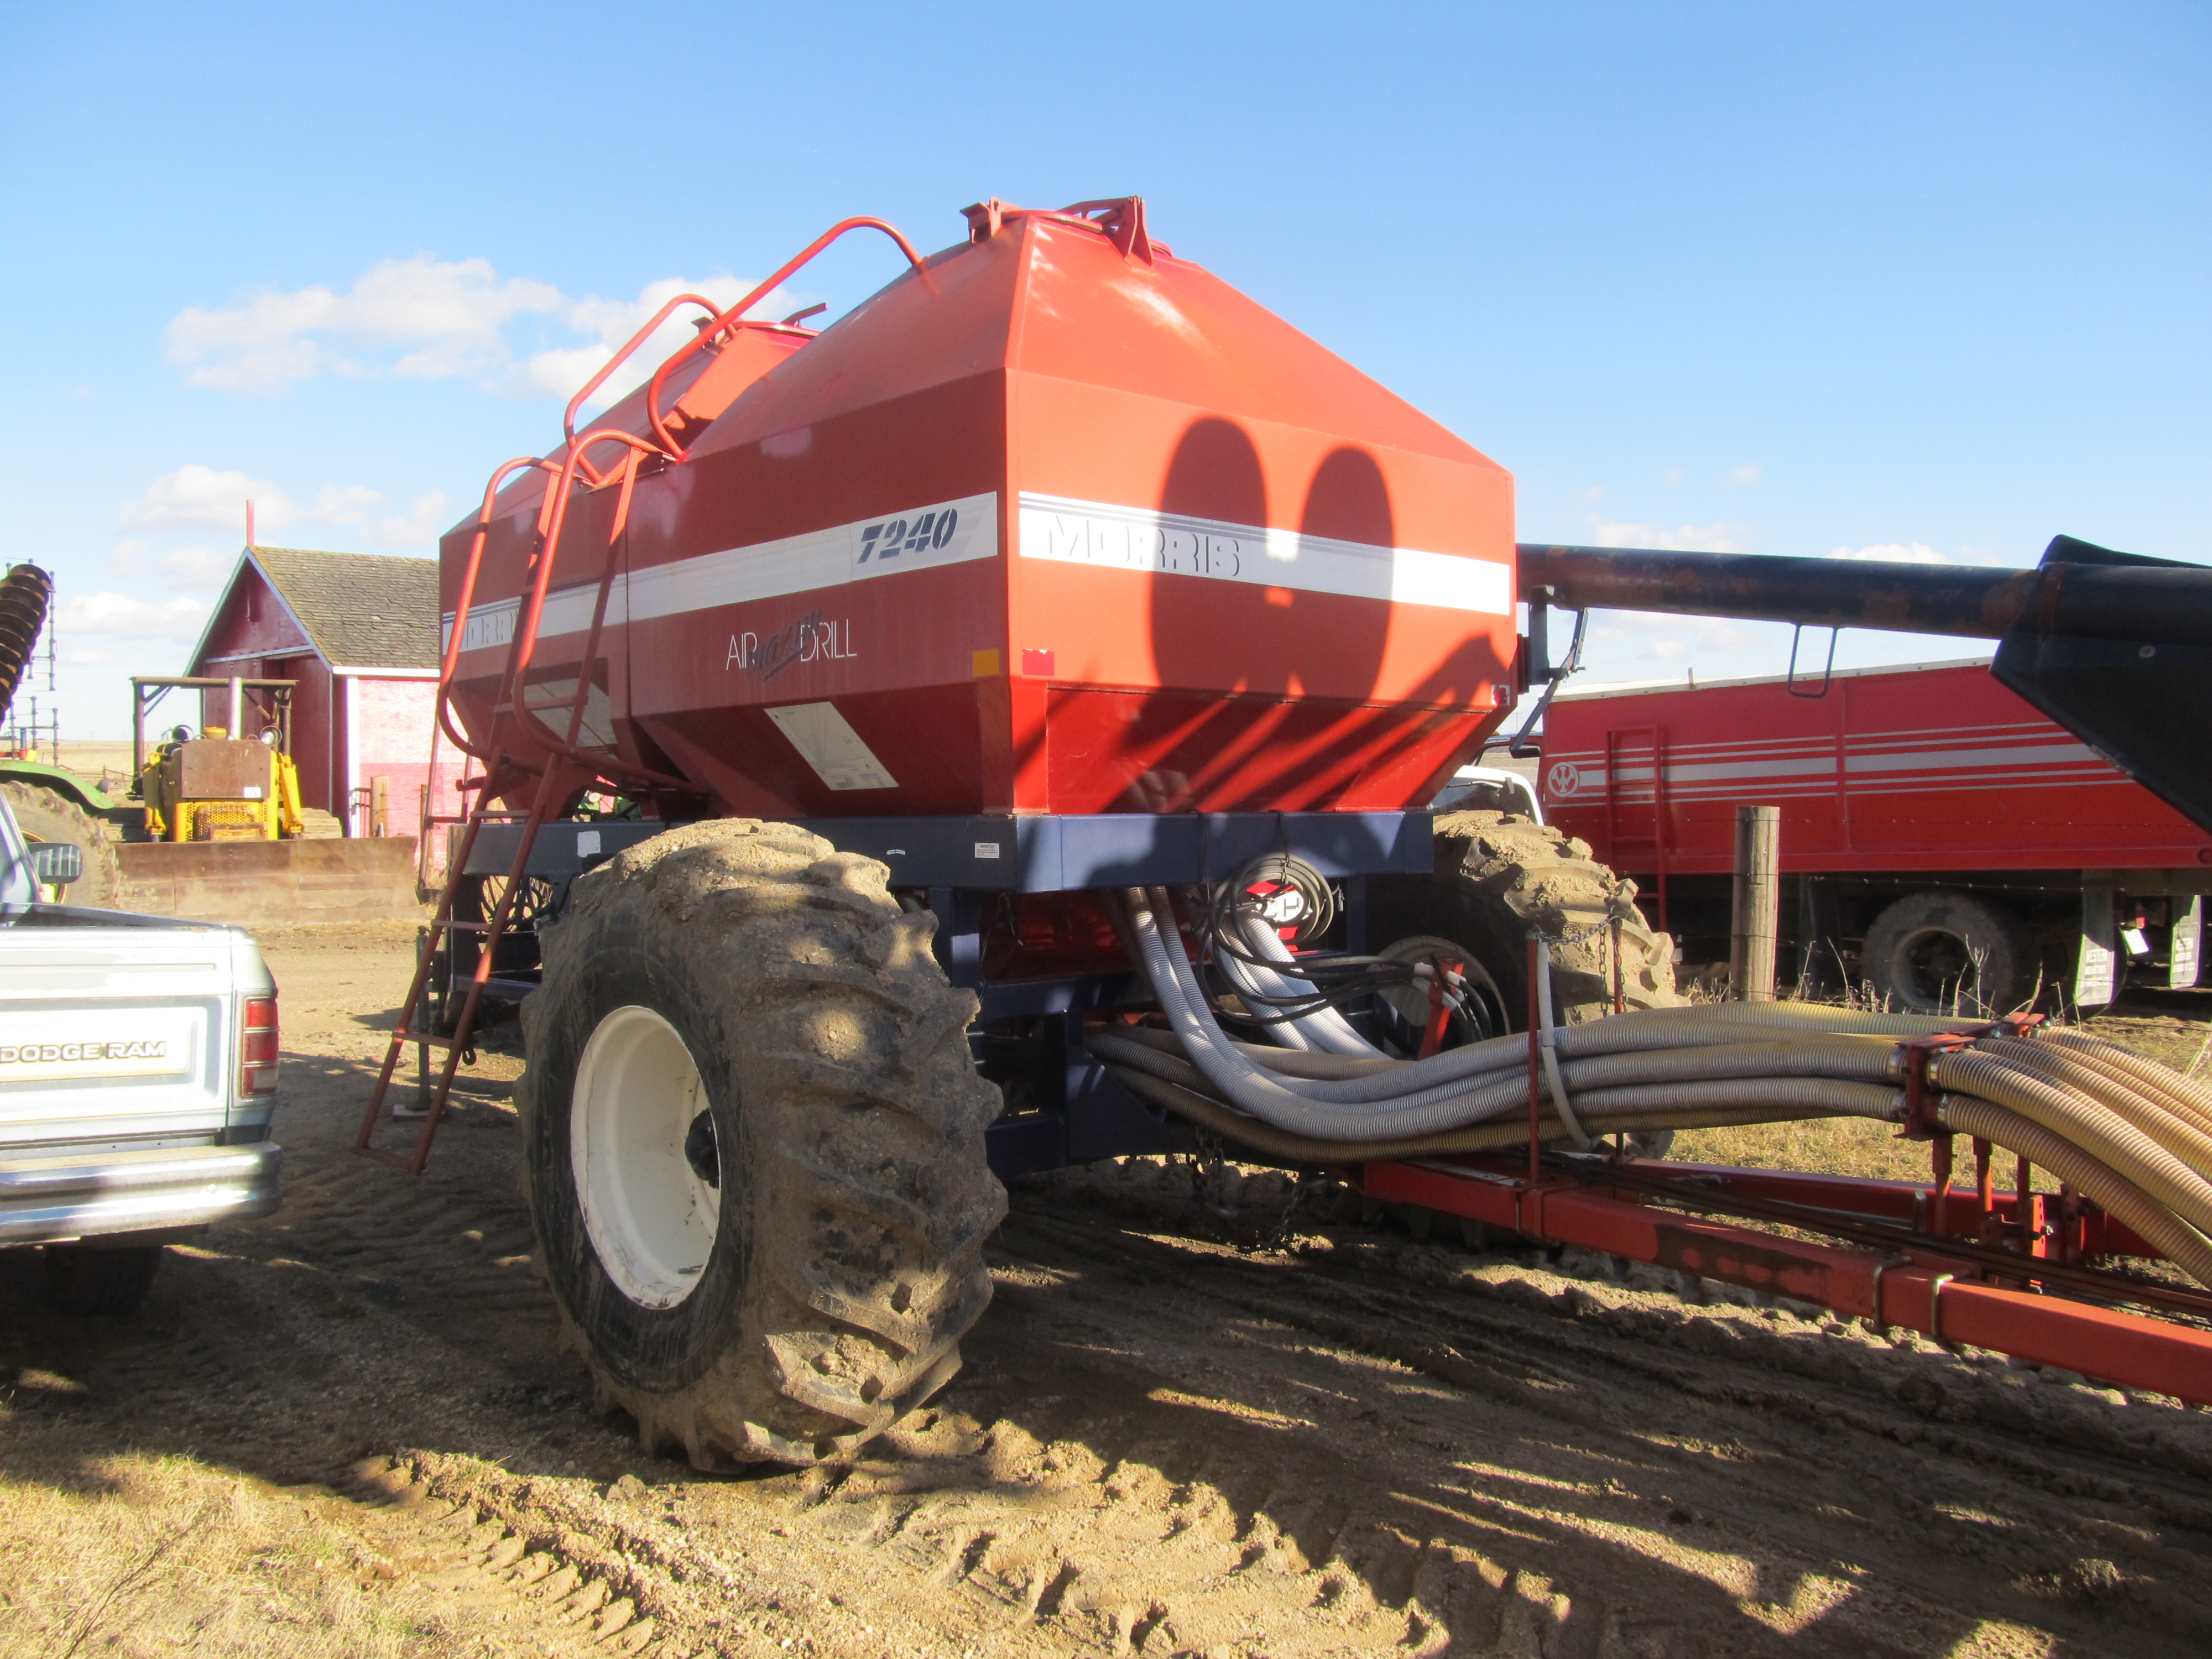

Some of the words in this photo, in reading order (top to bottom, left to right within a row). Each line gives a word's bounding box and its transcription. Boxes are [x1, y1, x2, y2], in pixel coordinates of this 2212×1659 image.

[857, 508, 958, 564] 7240
[1048, 515, 1240, 576] MORRIS
[726, 632, 758, 670] AIR
[800, 618, 858, 662] DRILL
[0, 1042, 102, 1063] DODGE
[106, 1041, 166, 1059] RAM
